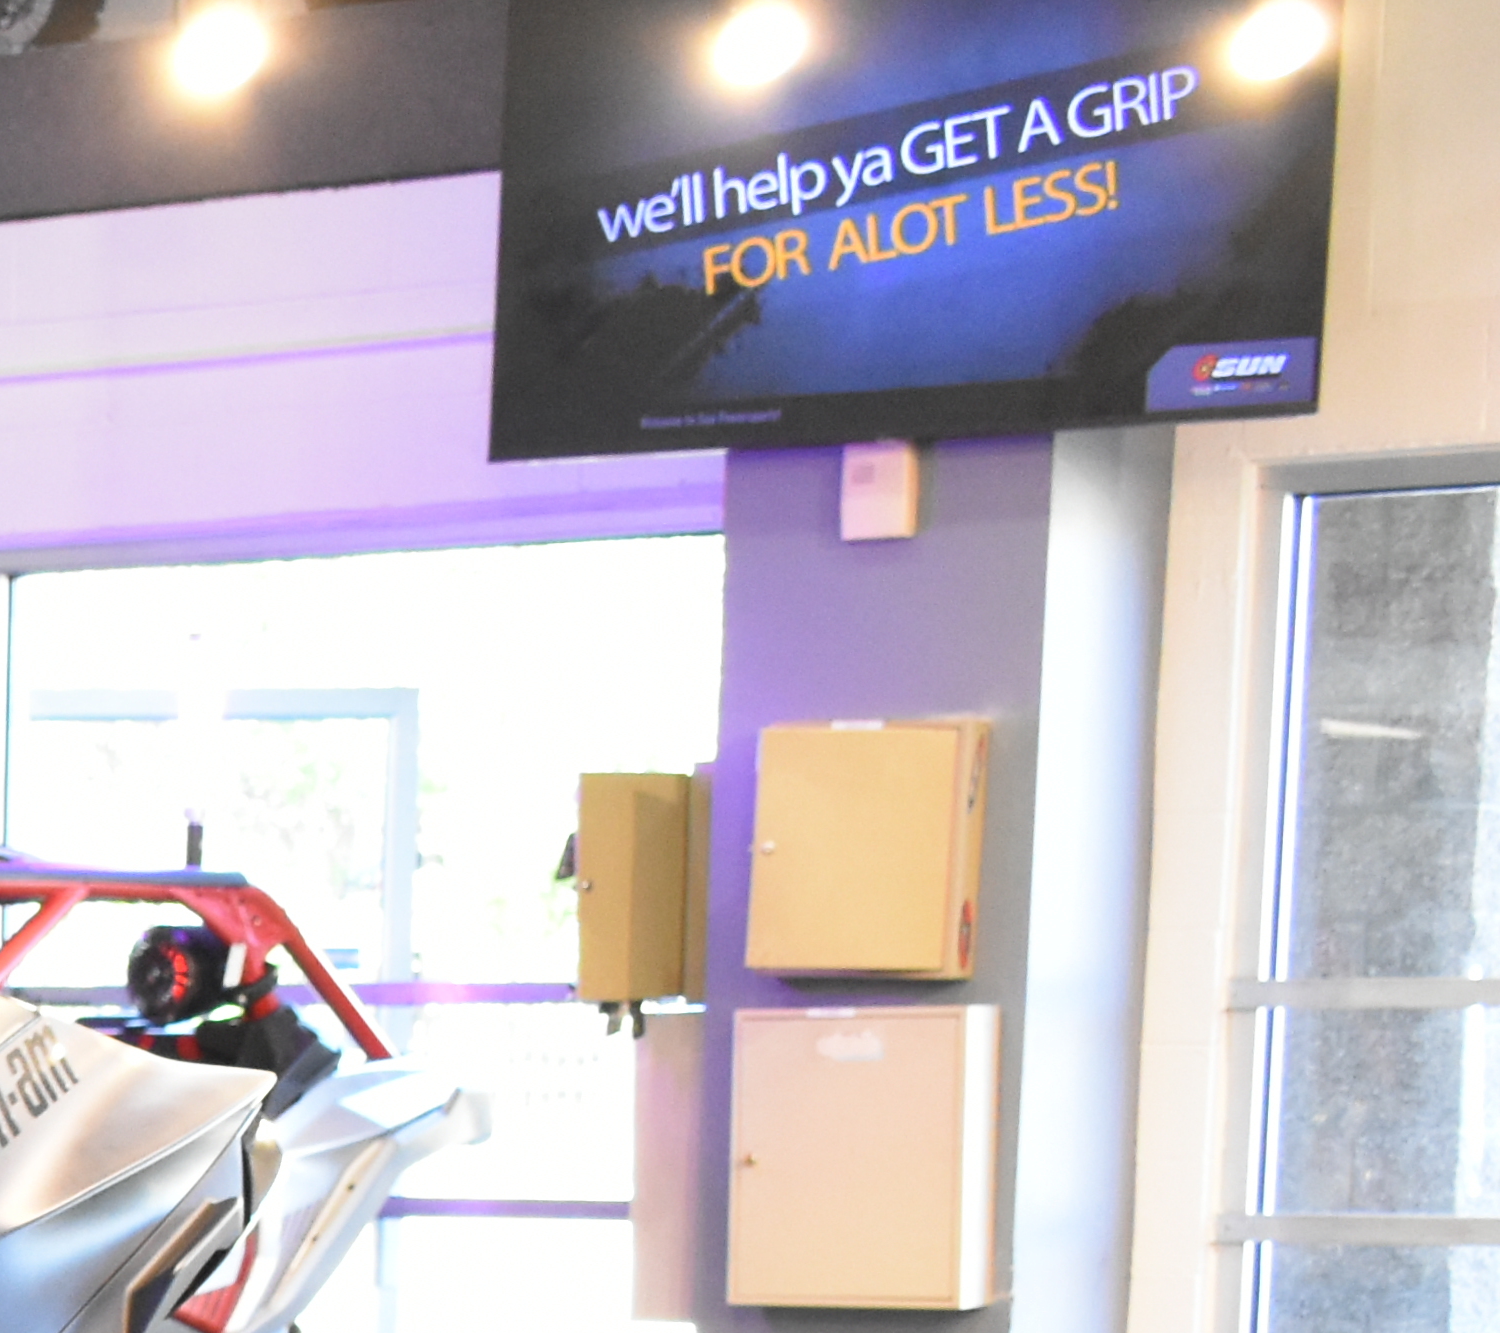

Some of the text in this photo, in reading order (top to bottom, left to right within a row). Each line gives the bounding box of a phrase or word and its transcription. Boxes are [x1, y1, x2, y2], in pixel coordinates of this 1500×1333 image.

[597, 64, 1200, 243] we'll help ya GET A GRIP
[702, 160, 1120, 296] FOR ALOT LESS!
[1211, 354, 1288, 378] SUN
